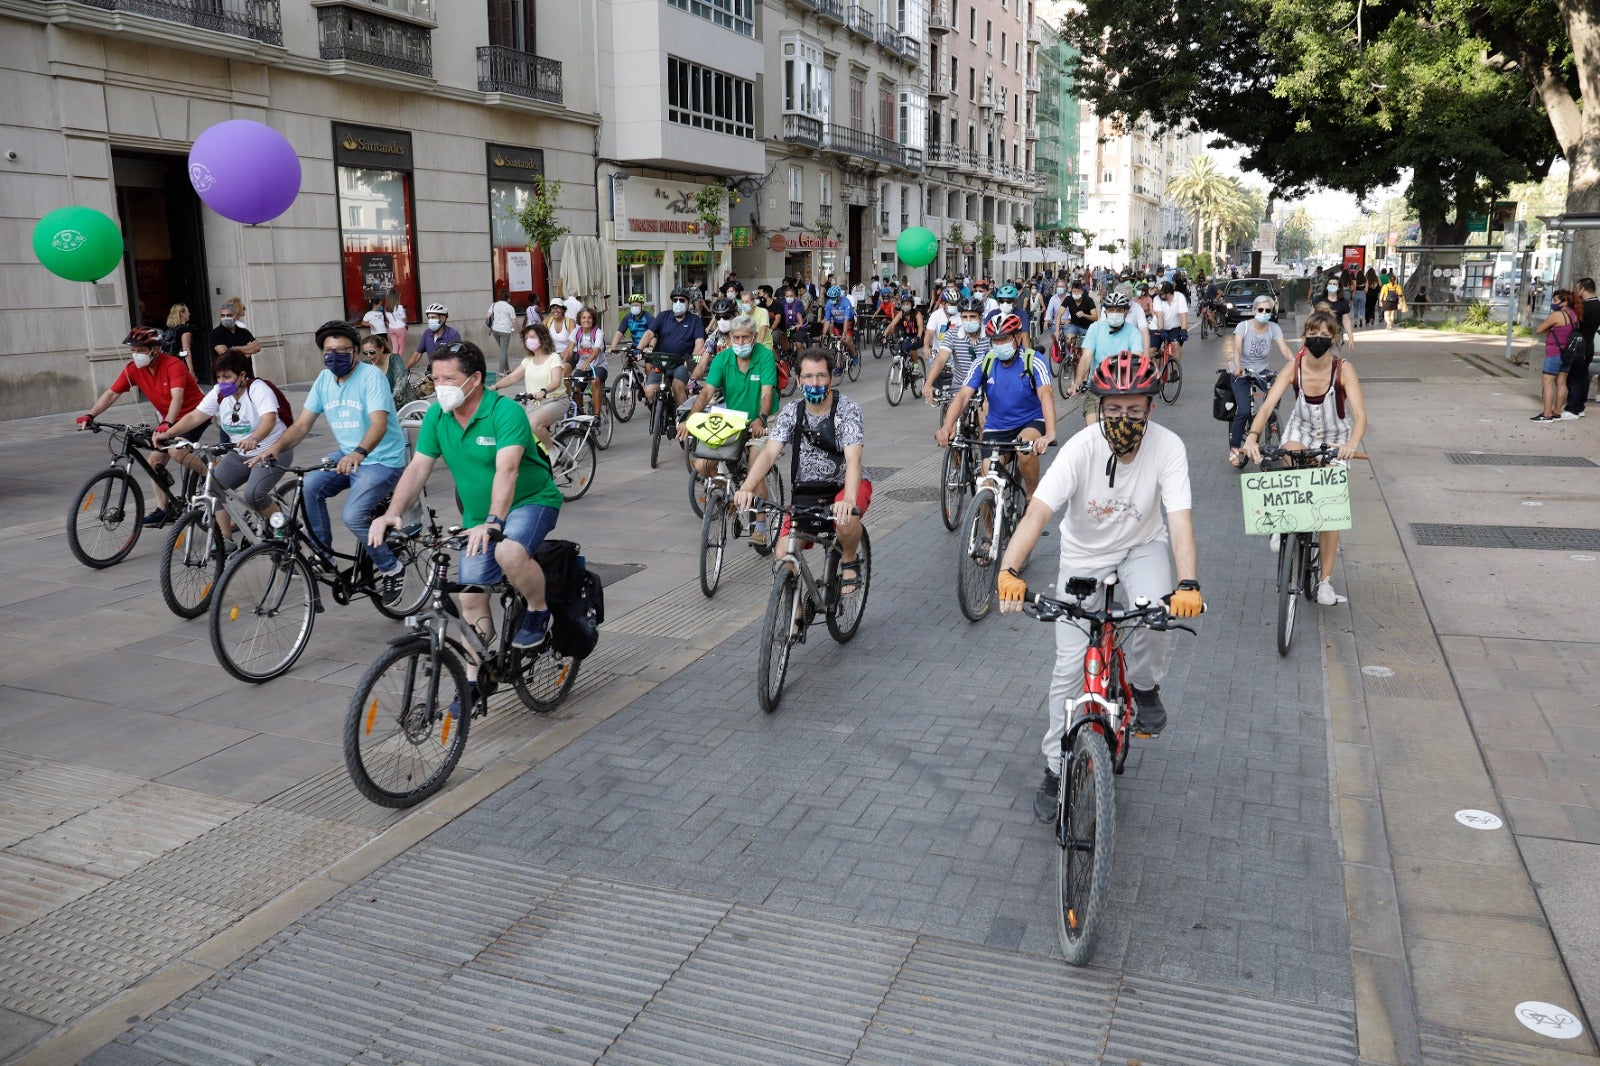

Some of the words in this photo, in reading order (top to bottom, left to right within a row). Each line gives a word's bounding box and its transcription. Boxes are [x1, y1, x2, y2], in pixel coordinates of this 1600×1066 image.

[358, 138, 405, 155] Santander
[505, 156, 539, 170] Santander
[628, 218, 659, 233] TURKISH
[1263, 490, 1314, 507] MATTER
